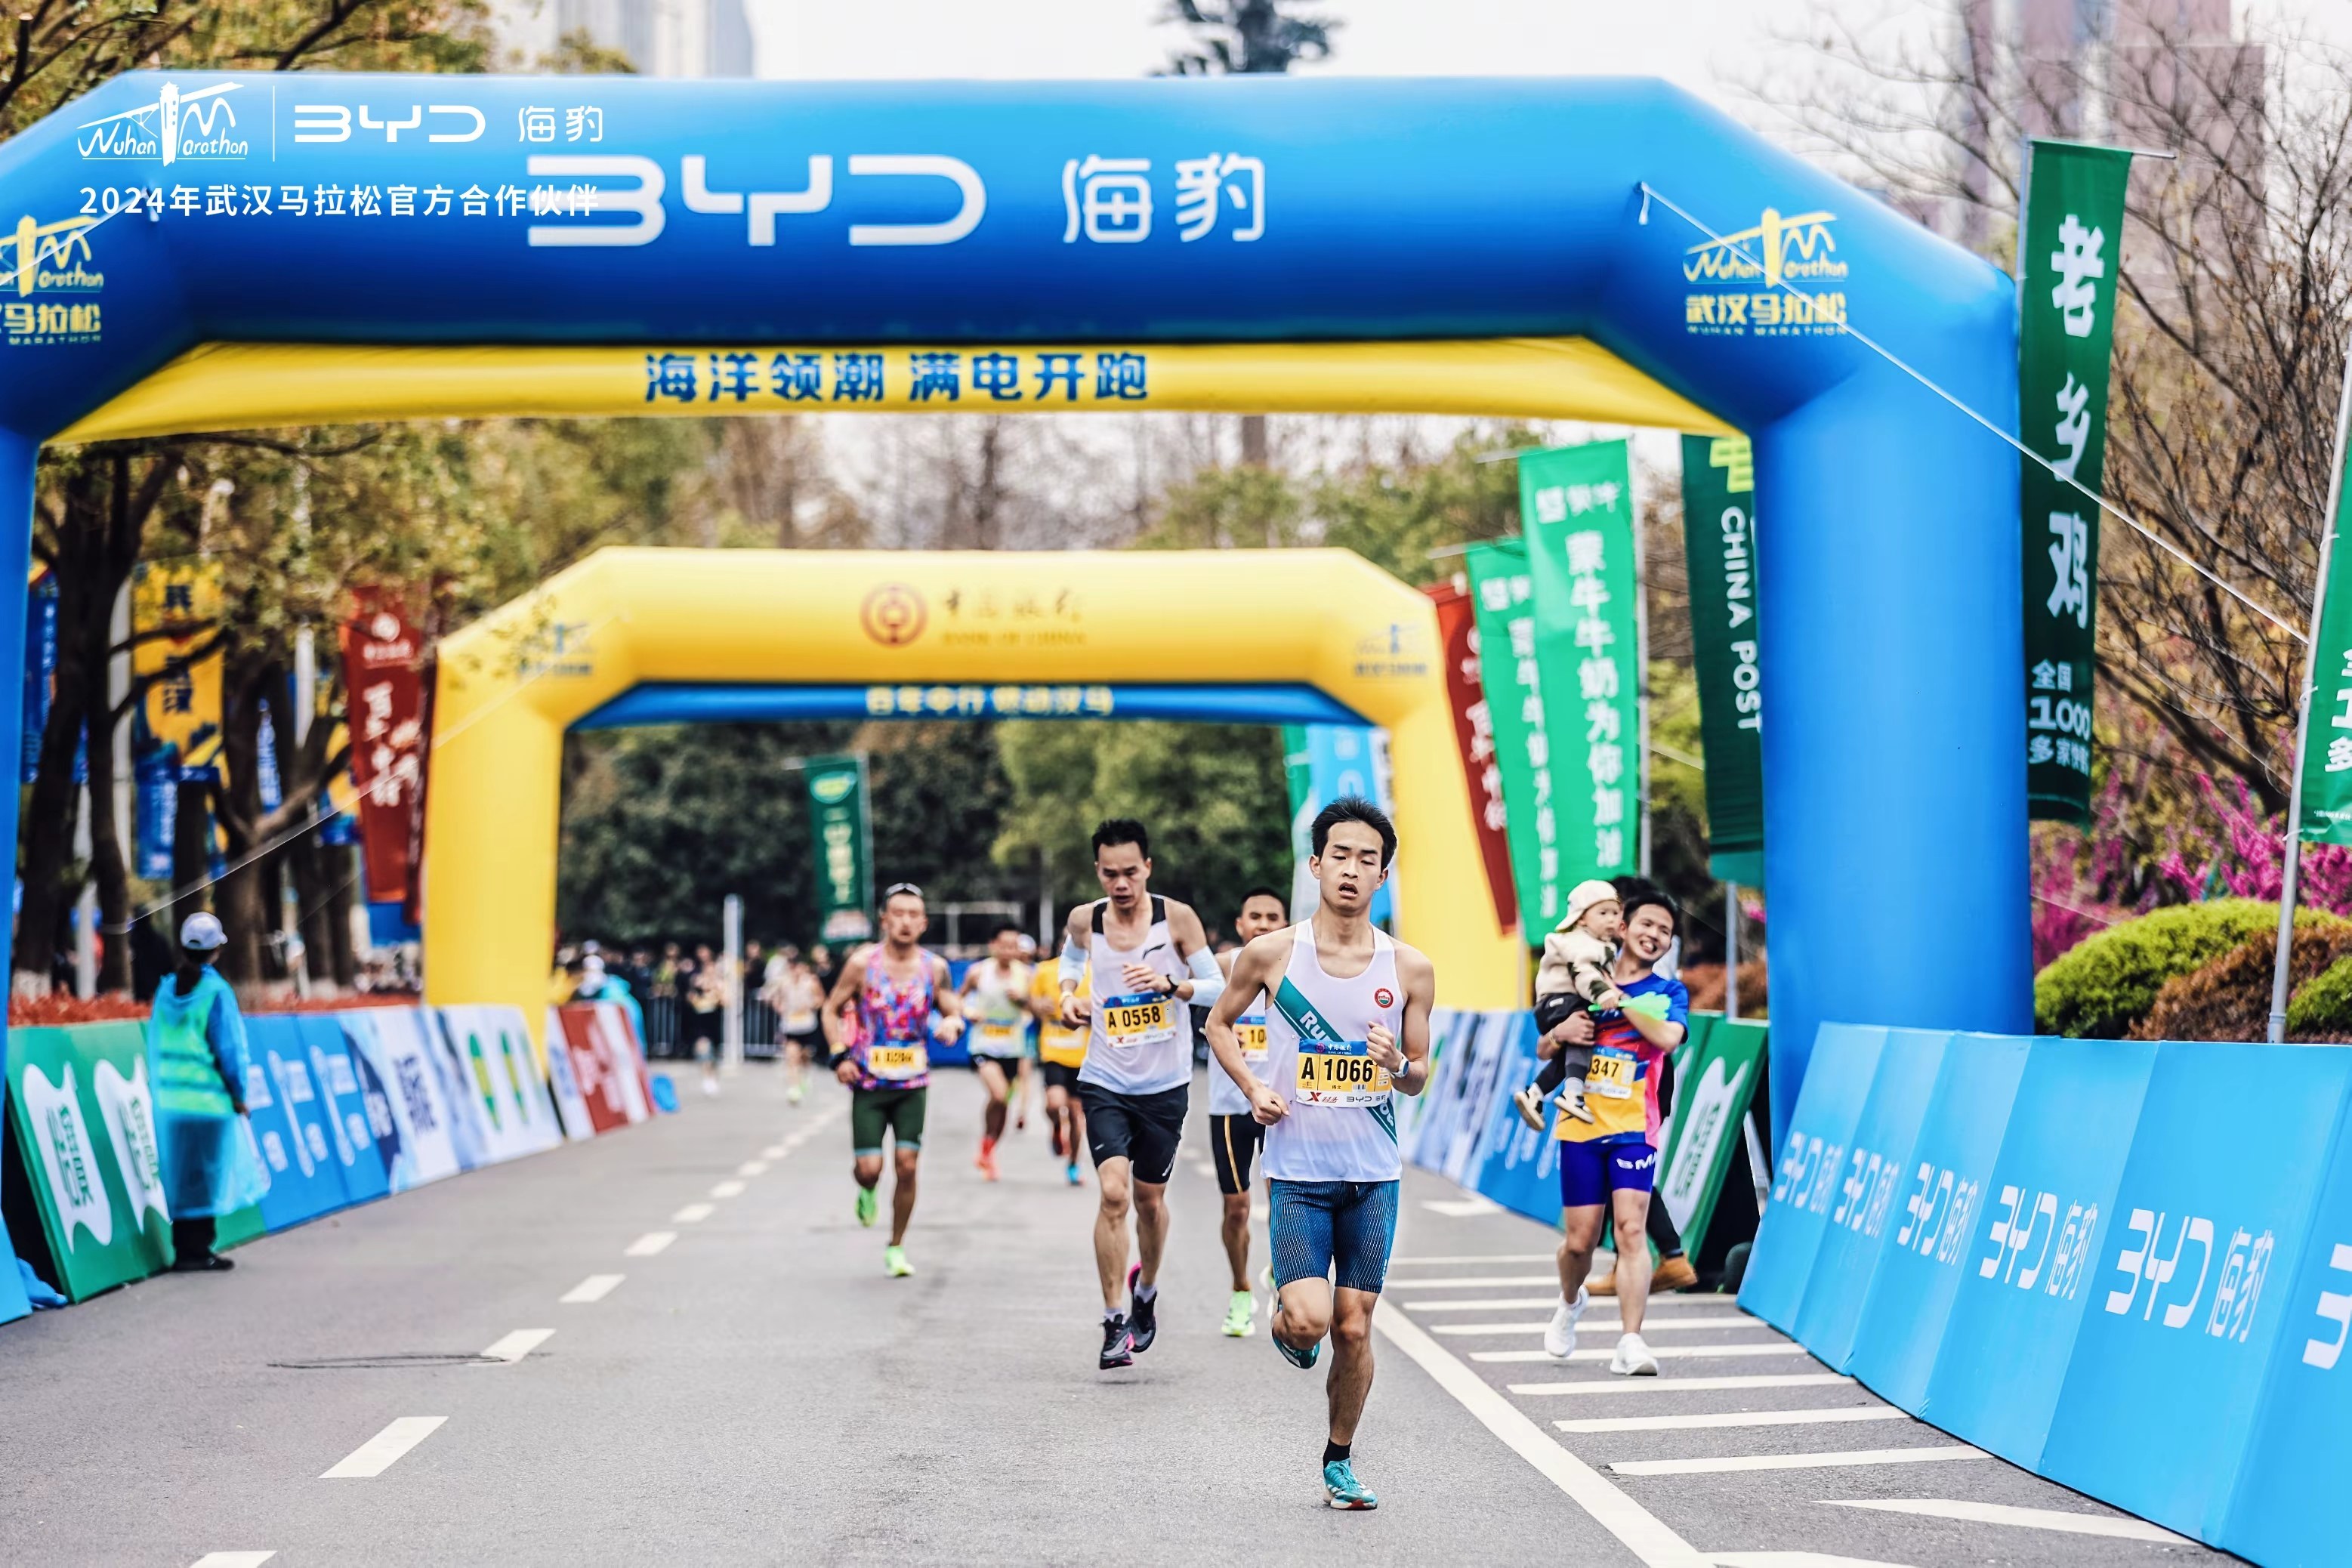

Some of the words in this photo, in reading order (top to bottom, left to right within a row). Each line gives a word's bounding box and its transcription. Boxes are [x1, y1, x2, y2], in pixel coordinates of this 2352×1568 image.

[526, 154, 986, 246] BYD
[1062, 152, 1266, 243] 海豹
[0, 303, 102, 335] 马拉松
[1685, 292, 1847, 326] 武汉马拉松
[644, 353, 885, 403] 海洋领潮
[909, 353, 1148, 402] 满电开跑
[2046, 214, 2104, 629] 老乡鸡
[1721, 505, 1753, 628] CHINA
[1730, 640, 1762, 733] POST
[2032, 659, 2072, 693] 全国
[1108, 1011, 1116, 1028] A
[1122, 1005, 1161, 1027] 0558
[1301, 1057, 1314, 1080] A
[1324, 1058, 1374, 1082] 1066
[1588, 1058, 1619, 1078] 347
[1897, 1162, 1955, 1257] BYD
[1979, 1185, 2058, 1290] BYD
[2105, 1208, 2215, 1329] BYD
[2205, 1226, 2274, 1343] 海豹
